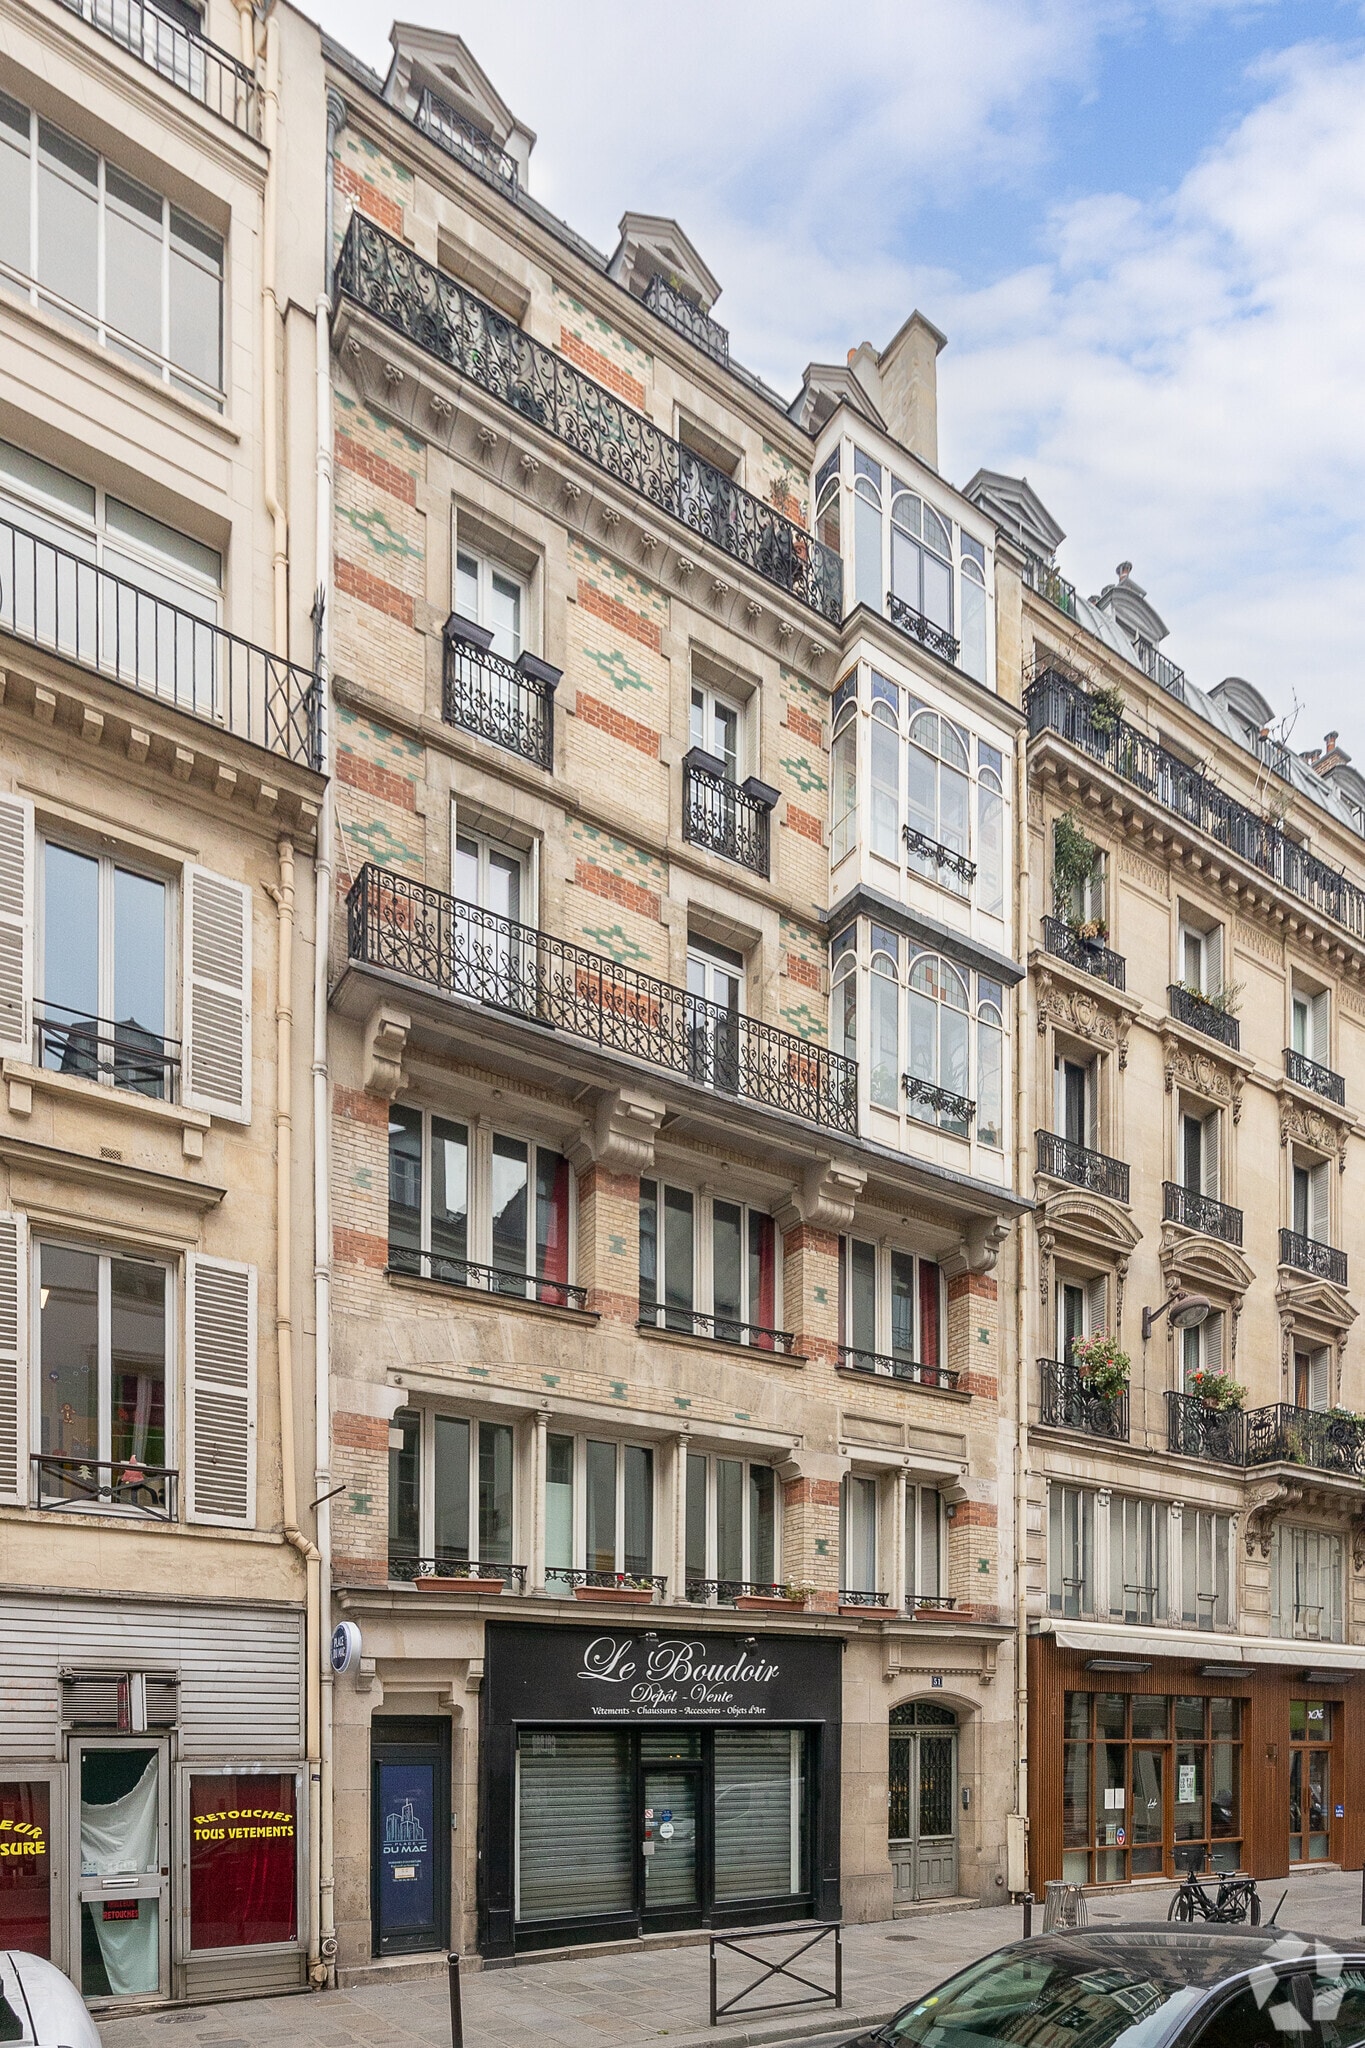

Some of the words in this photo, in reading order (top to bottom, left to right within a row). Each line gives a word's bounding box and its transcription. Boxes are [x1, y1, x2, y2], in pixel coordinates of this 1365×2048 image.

[576, 1636, 636, 1683] Le
[645, 1640, 780, 1683] Boudoir
[629, 1682, 678, 1708] Dépôt
[690, 1681, 734, 1704] Vente
[591, 1706, 631, 1715] Vêtements
[636, 1704, 678, 1715] Chaussures
[684, 1706, 721, 1715] Accessoires
[726, 1704, 747, 1718] Objets
[748, 1704, 767, 1715] d'Art
[193, 1809, 293, 1825] RETOUCHES
[193, 1828, 226, 1841] TOUS
[228, 1825, 294, 1839] VETEMENTS
[383, 1846, 399, 1854] DU
[401, 1845, 427, 1853] MAC
[103, 1909, 139, 1920] RETOUCHES
